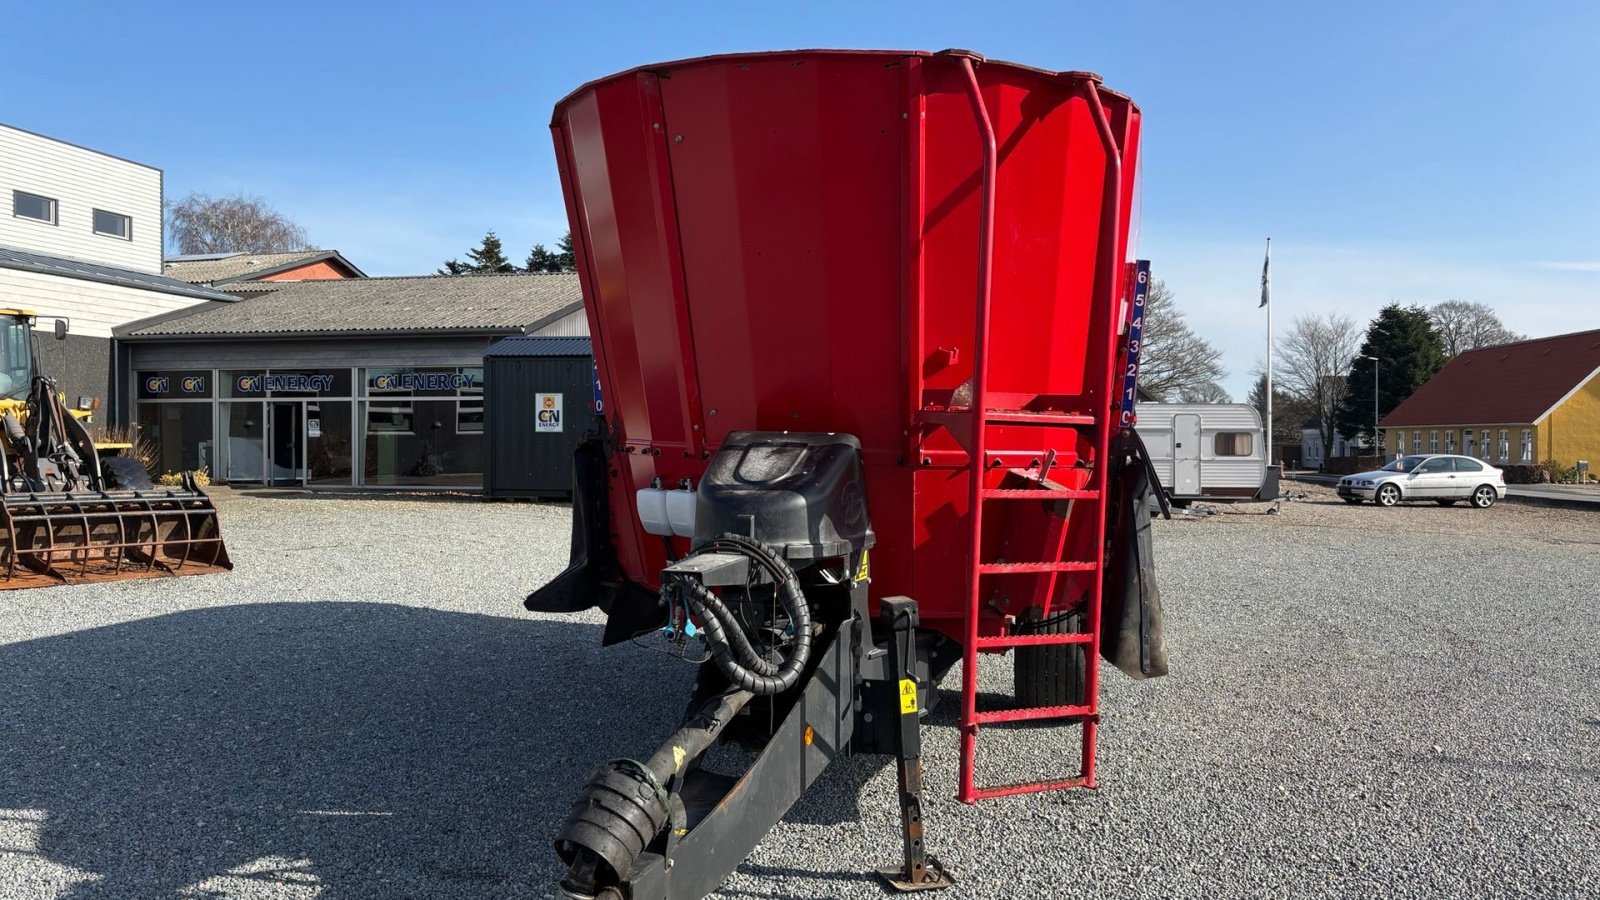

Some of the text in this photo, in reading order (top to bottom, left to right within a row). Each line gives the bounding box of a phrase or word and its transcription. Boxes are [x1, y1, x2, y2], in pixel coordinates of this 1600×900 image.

[1137, 271, 1147, 284] 6
[1135, 294, 1145, 306] 5
[1132, 317, 1142, 330] 4
[1130, 340, 1139, 353] 3
[1126, 364, 1136, 377] 2
[146, 376, 169, 392] CN
[181, 376, 205, 392] CN
[237, 375, 334, 392] CN ENERGY
[374, 373, 476, 390] CN ENERGY
[1127, 387, 1133, 400] 1
[596, 400, 602, 411] 0
[538, 410, 559, 422] CN
